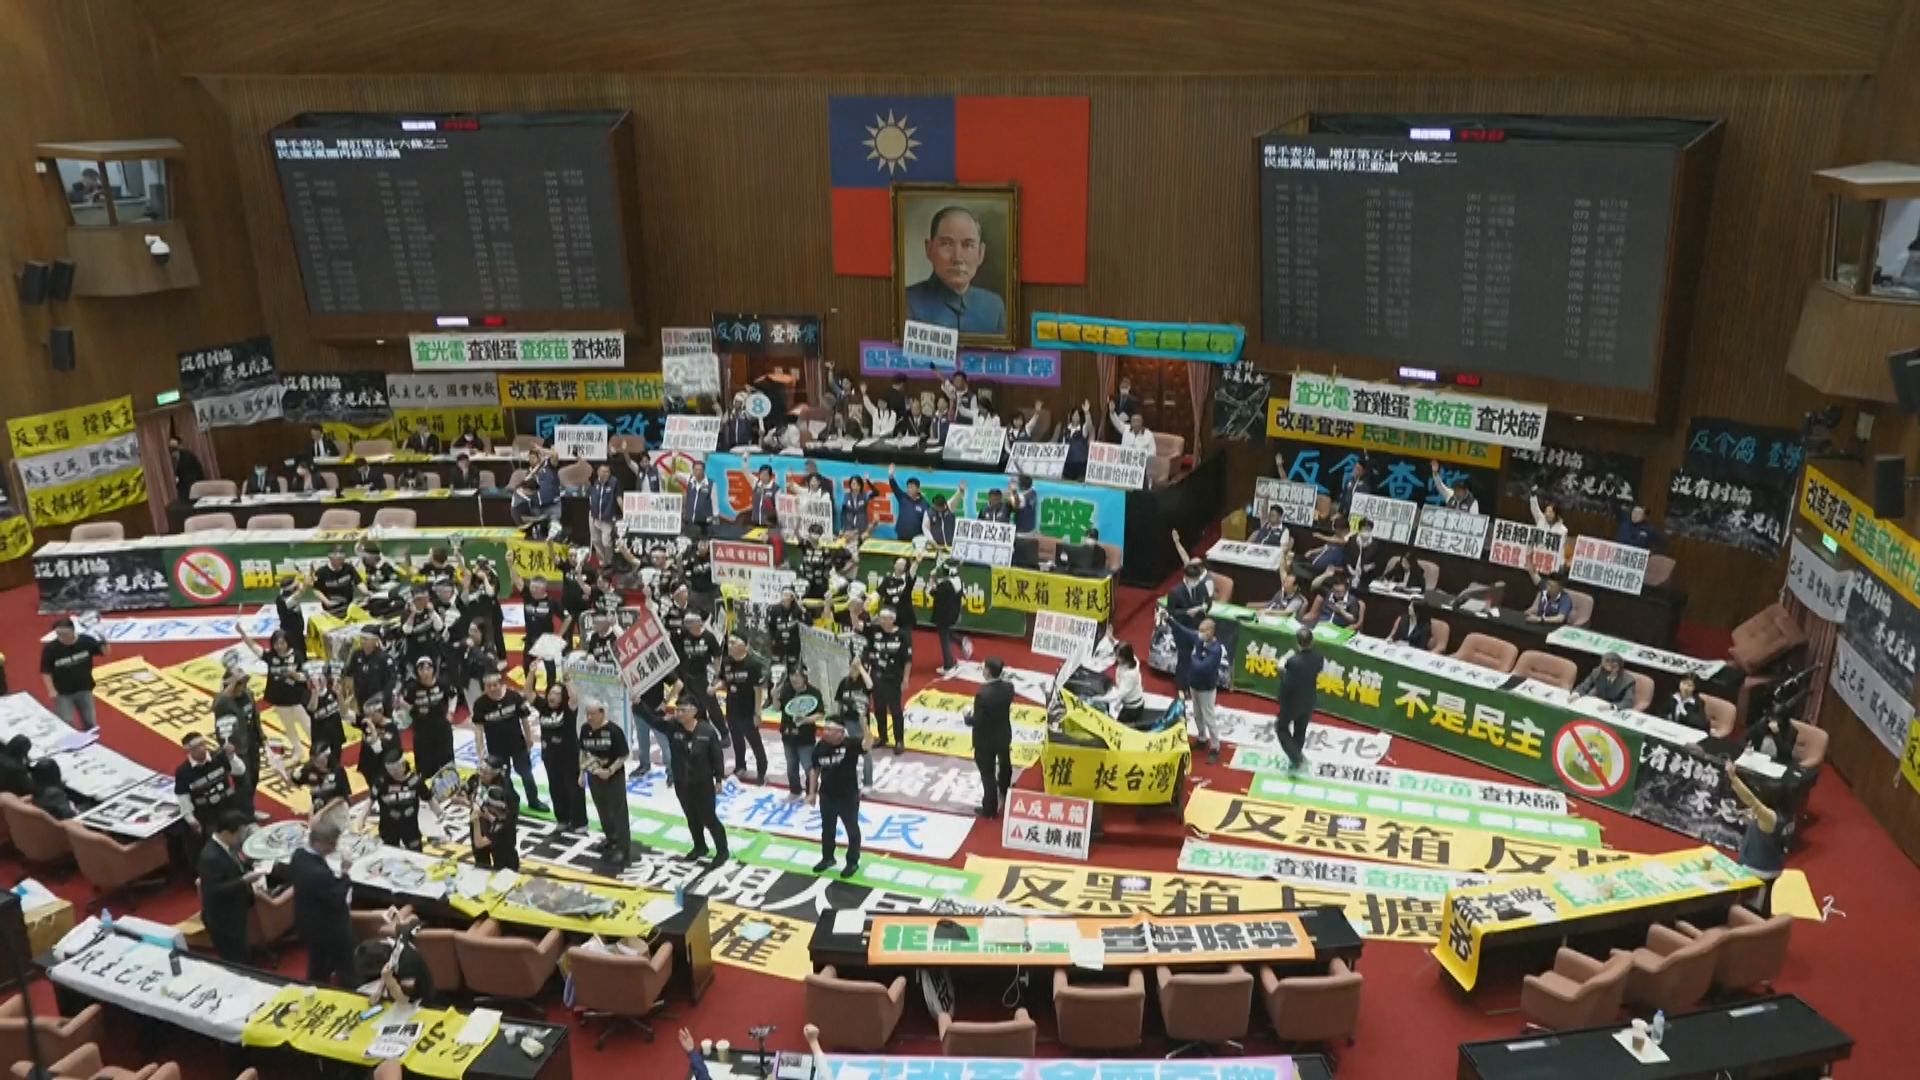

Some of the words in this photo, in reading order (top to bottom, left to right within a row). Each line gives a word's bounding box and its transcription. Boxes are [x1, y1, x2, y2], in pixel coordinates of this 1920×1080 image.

[414, 340, 466, 362] 查光電
[467, 339, 518, 361] 查雞蛋
[519, 338, 569, 361] 查疫苗
[571, 337, 622, 361] 查快篩
[508, 380, 578, 400] 改革查弊
[752, 398, 765, 413] 8
[1276, 406, 1356, 438] 改革查弊
[1295, 380, 1350, 411] 查光電
[1352, 388, 1411, 420] 查雞蛋
[1411, 398, 1474, 430] 查疫苗
[1475, 404, 1543, 440] 查快篩
[956, 519, 1013, 545] 國會改革
[1417, 528, 1480, 554] 民主之恥
[1495, 520, 1563, 553] 拒絕黑箱
[1571, 558, 1642, 591] 民進黨怕什麼?
[993, 575, 1050, 607] 反黑箱
[1244, 641, 1384, 708] 綠集權
[1395, 680, 1546, 760] 不是民主
[1094, 762, 1176, 795] 挺台灣
[1026, 799, 1086, 825] 反黑箱
[1477, 785, 1563, 812] 查快篩
[1024, 825, 1083, 850] 反擴權
[1217, 798, 1454, 866] 反黑箱
[1272, 856, 1358, 887] 查雞蛋
